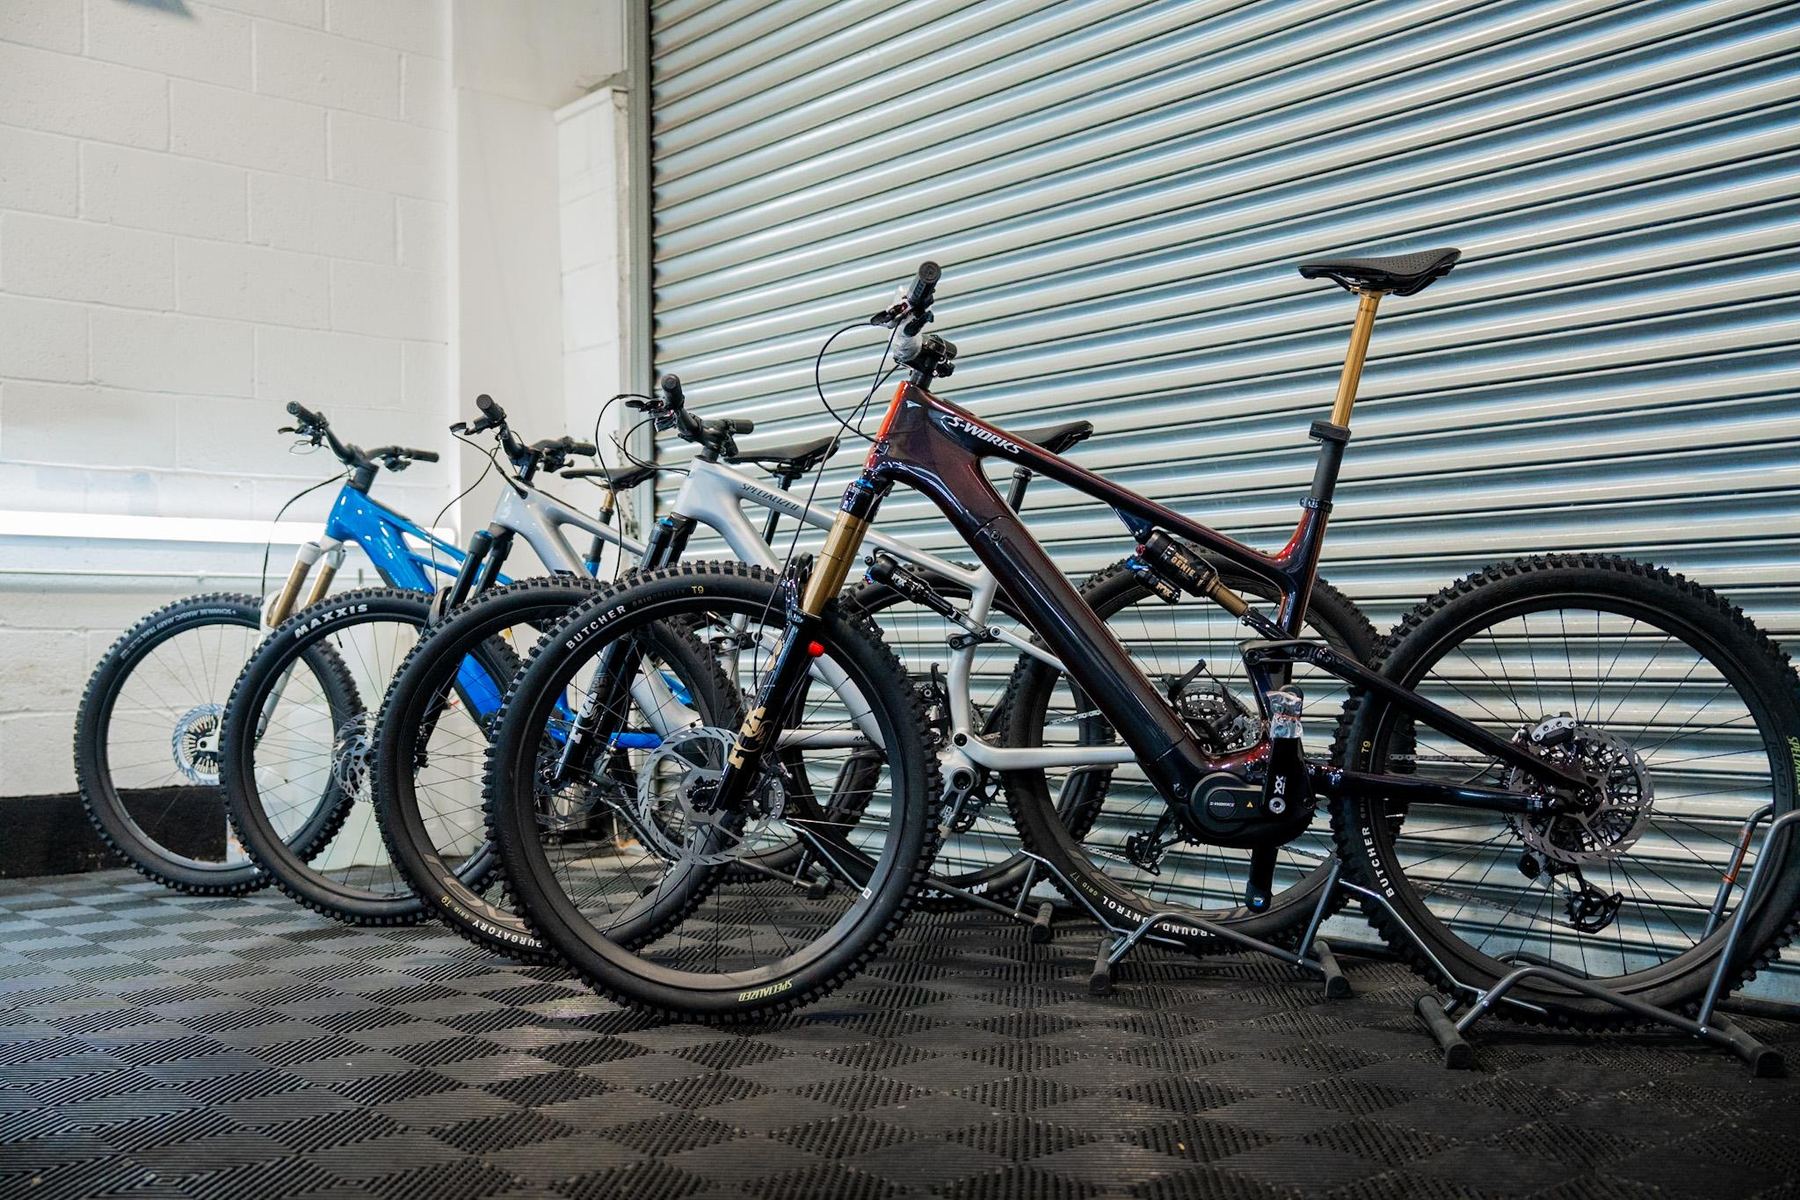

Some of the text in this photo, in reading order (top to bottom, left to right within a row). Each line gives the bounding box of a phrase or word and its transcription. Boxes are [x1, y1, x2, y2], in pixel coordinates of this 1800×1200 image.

[947, 415, 1024, 455] S-WORKS
[742, 483, 800, 511] SPECIALIZED
[1171, 556, 1197, 578] GENIE
[294, 604, 368, 639] MAXXIS
[566, 605, 627, 650] BUTCHER
[691, 585, 704, 595] T9
[1361, 740, 1372, 753] T9
[1361, 826, 1396, 898] BUTCHER
[441, 895, 452, 908] T9
[1162, 923, 1216, 938] ROUND
[738, 978, 793, 1002] SPECIALIZED
